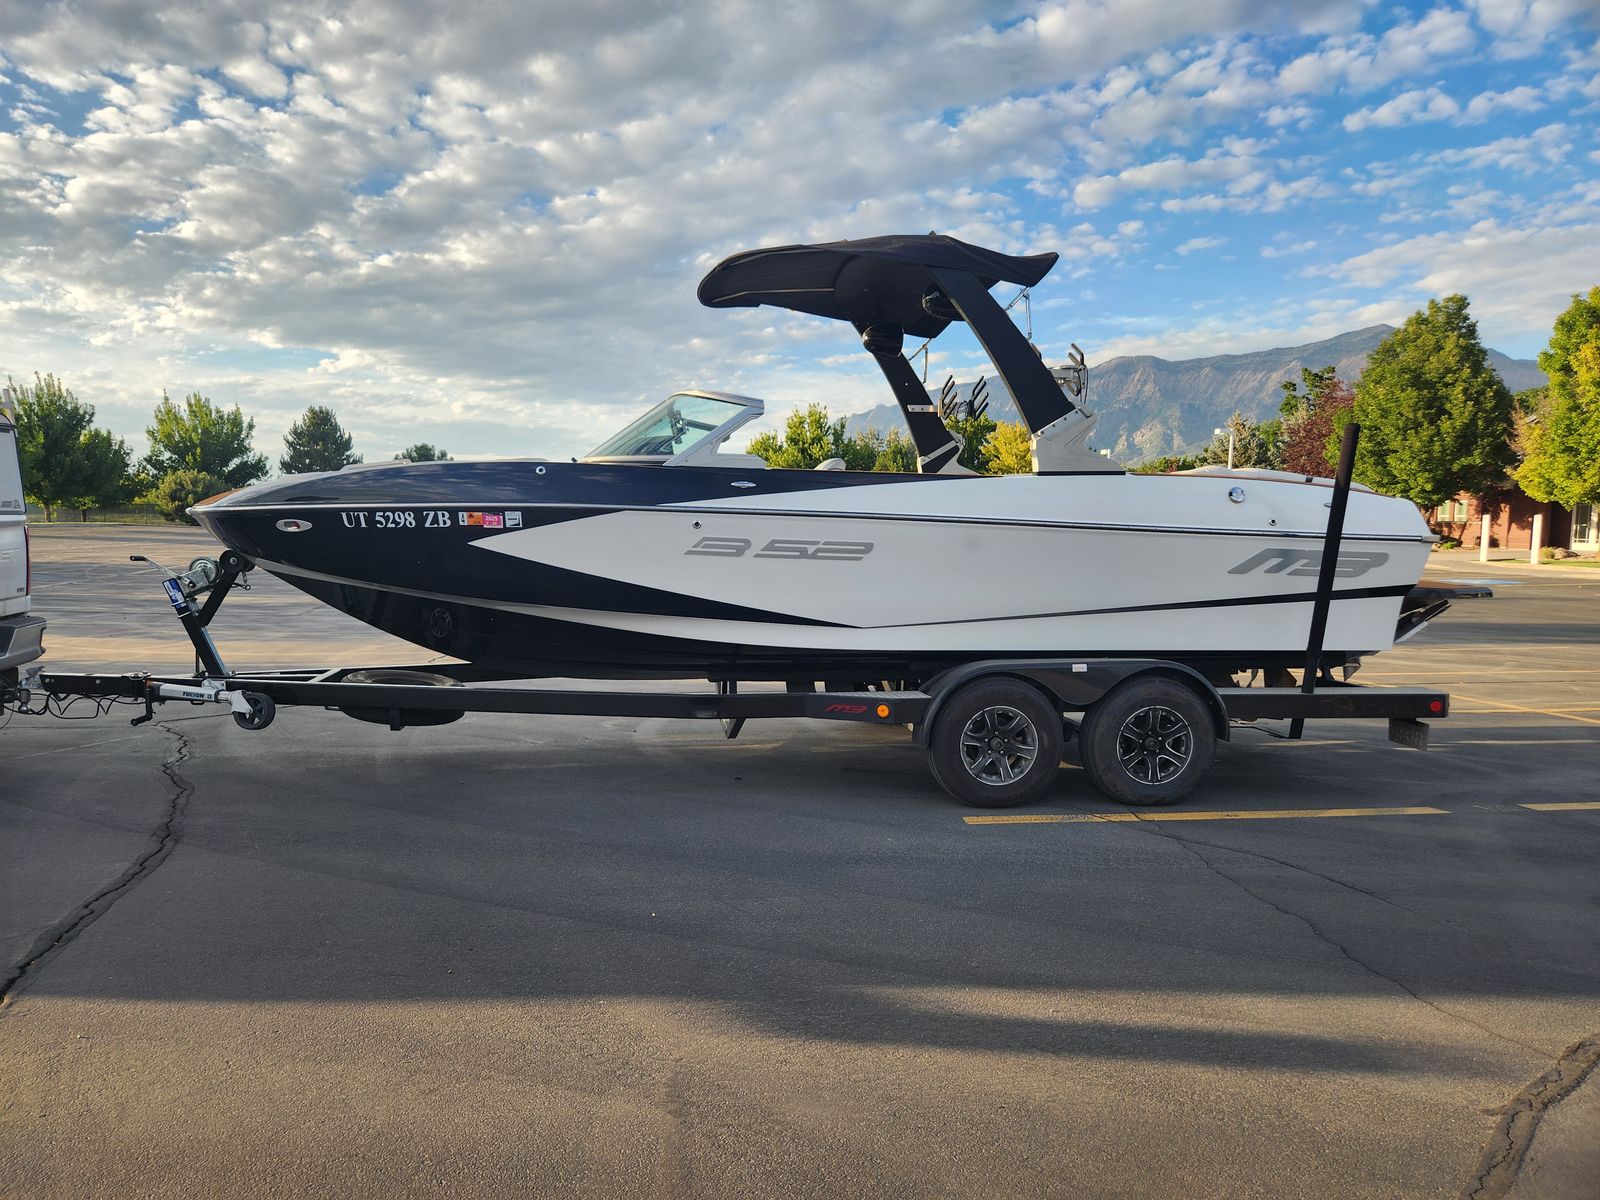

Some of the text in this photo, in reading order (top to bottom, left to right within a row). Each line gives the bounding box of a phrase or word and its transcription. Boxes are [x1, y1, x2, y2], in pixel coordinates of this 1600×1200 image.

[340, 510, 452, 528] UT 5298 ZB
